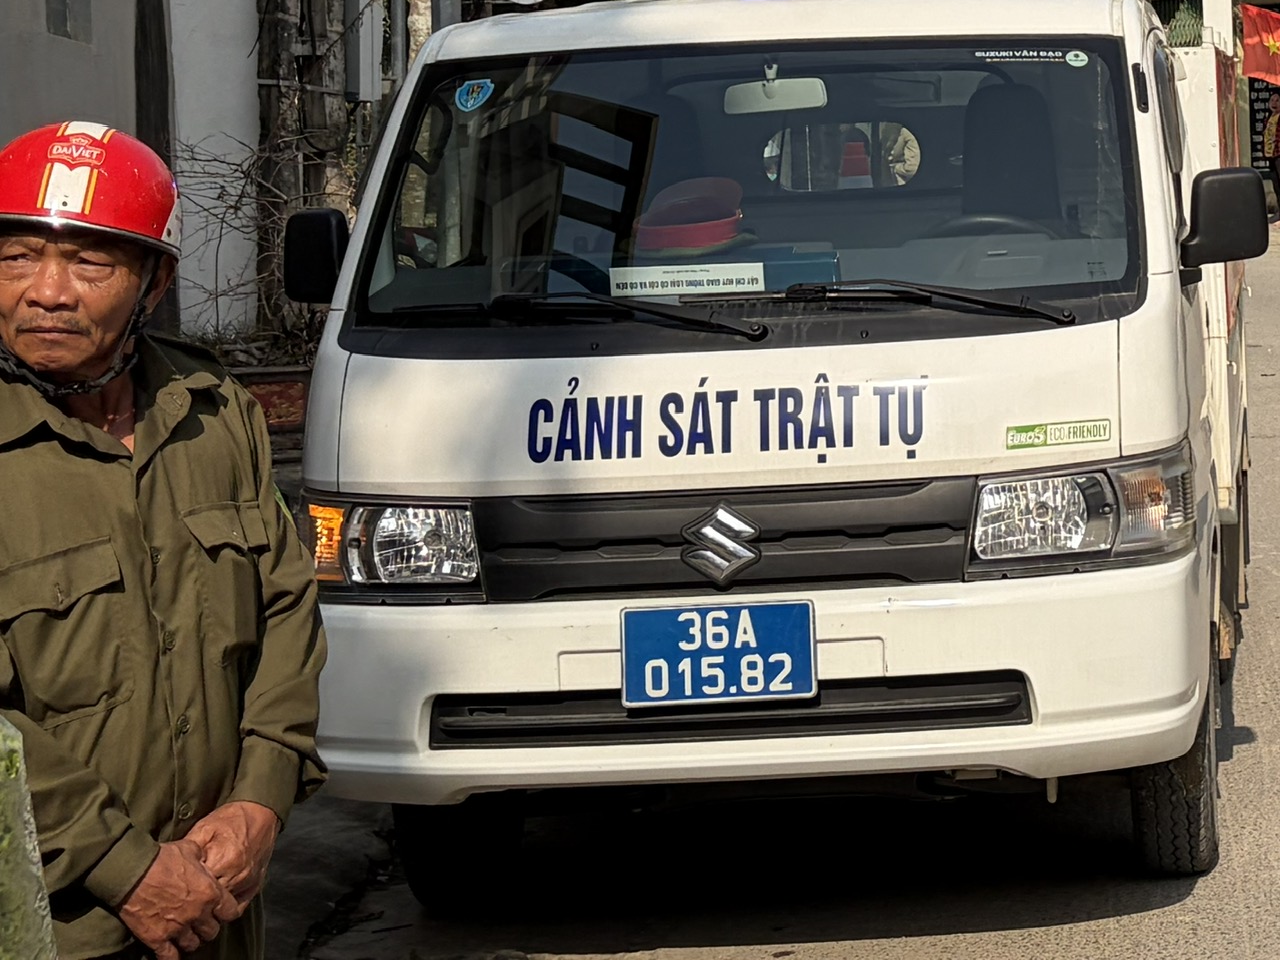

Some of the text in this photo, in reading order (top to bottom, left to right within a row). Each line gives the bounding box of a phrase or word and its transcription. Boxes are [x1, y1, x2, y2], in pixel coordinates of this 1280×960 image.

[685, 279, 705, 288] THÔNG
[706, 279, 720, 287] GIAO
[527, 372, 929, 464] CẢNH SÁT TRẬT TỰ
[1049, 426, 1066, 441] ECO
[1068, 423, 1108, 439] FRIENDLY
[677, 608, 757, 651] 36A
[644, 652, 793, 699] 015.82
